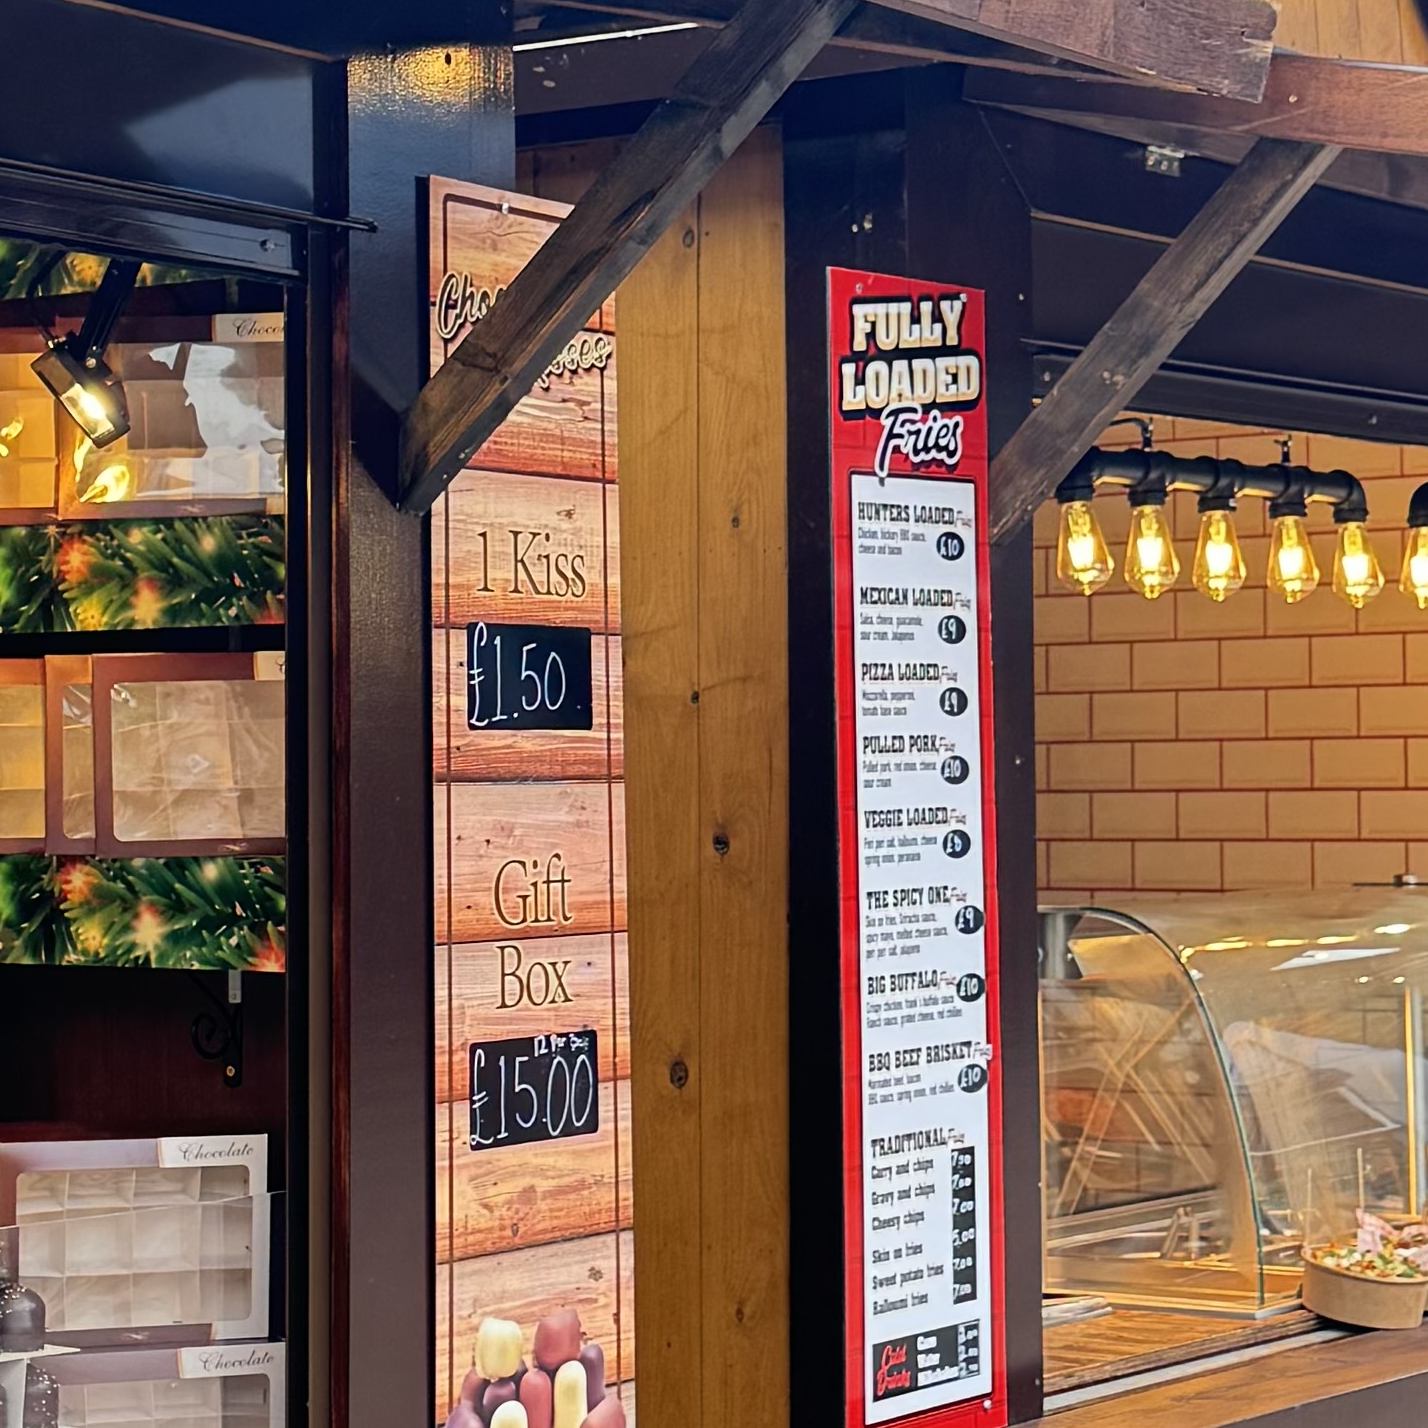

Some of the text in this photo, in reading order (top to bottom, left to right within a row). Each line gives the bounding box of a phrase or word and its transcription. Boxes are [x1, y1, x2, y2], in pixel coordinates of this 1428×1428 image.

[851, 298, 964, 353] FULLY
[841, 354, 981, 411] LOADED
[874, 402, 964, 479] Fries
[858, 501, 910, 523] HUNTERS
[914, 504, 954, 526] LOADED
[938, 535, 961, 558] £10
[476, 529, 587, 599] 1 Kiss
[860, 586, 909, 606] MEXICAN
[912, 587, 954, 608] LOADED
[941, 617, 958, 639] £9
[469, 621, 567, 727] £1.50
[861, 663, 894, 681] PIZZA
[898, 662, 940, 681] LOADED
[863, 735, 905, 754] PULLED
[909, 734, 939, 754] PORK
[864, 808, 903, 829] VEGGIE
[906, 807, 948, 826] LOADED
[493, 852, 573, 927] Gift
[866, 890, 889, 910] THE
[892, 887, 924, 907] SPICY
[927, 885, 950, 904] ONE
[957, 907, 974, 930] £9
[495, 943, 573, 1010] Box
[867, 975, 886, 996] BIG
[889, 969, 939, 992] BUFFALO
[868, 1051, 891, 1073] BBQ
[895, 1047, 922, 1069] BEEF
[926, 1040, 973, 1064] BRISKET
[470, 1048, 593, 1146] £15.00
[178, 1140, 254, 1162] Chocolate
[871, 1127, 948, 1159] TRADITIONAL
[871, 1165, 892, 1181] Curry
[895, 1159, 910, 1175] and
[871, 1191, 894, 1206] Gravy
[897, 1185, 911, 1200] and
[872, 1216, 900, 1231] Cheesy
[872, 1273, 897, 1290] Sweet
[199, 1349, 275, 1371] Chocolate
